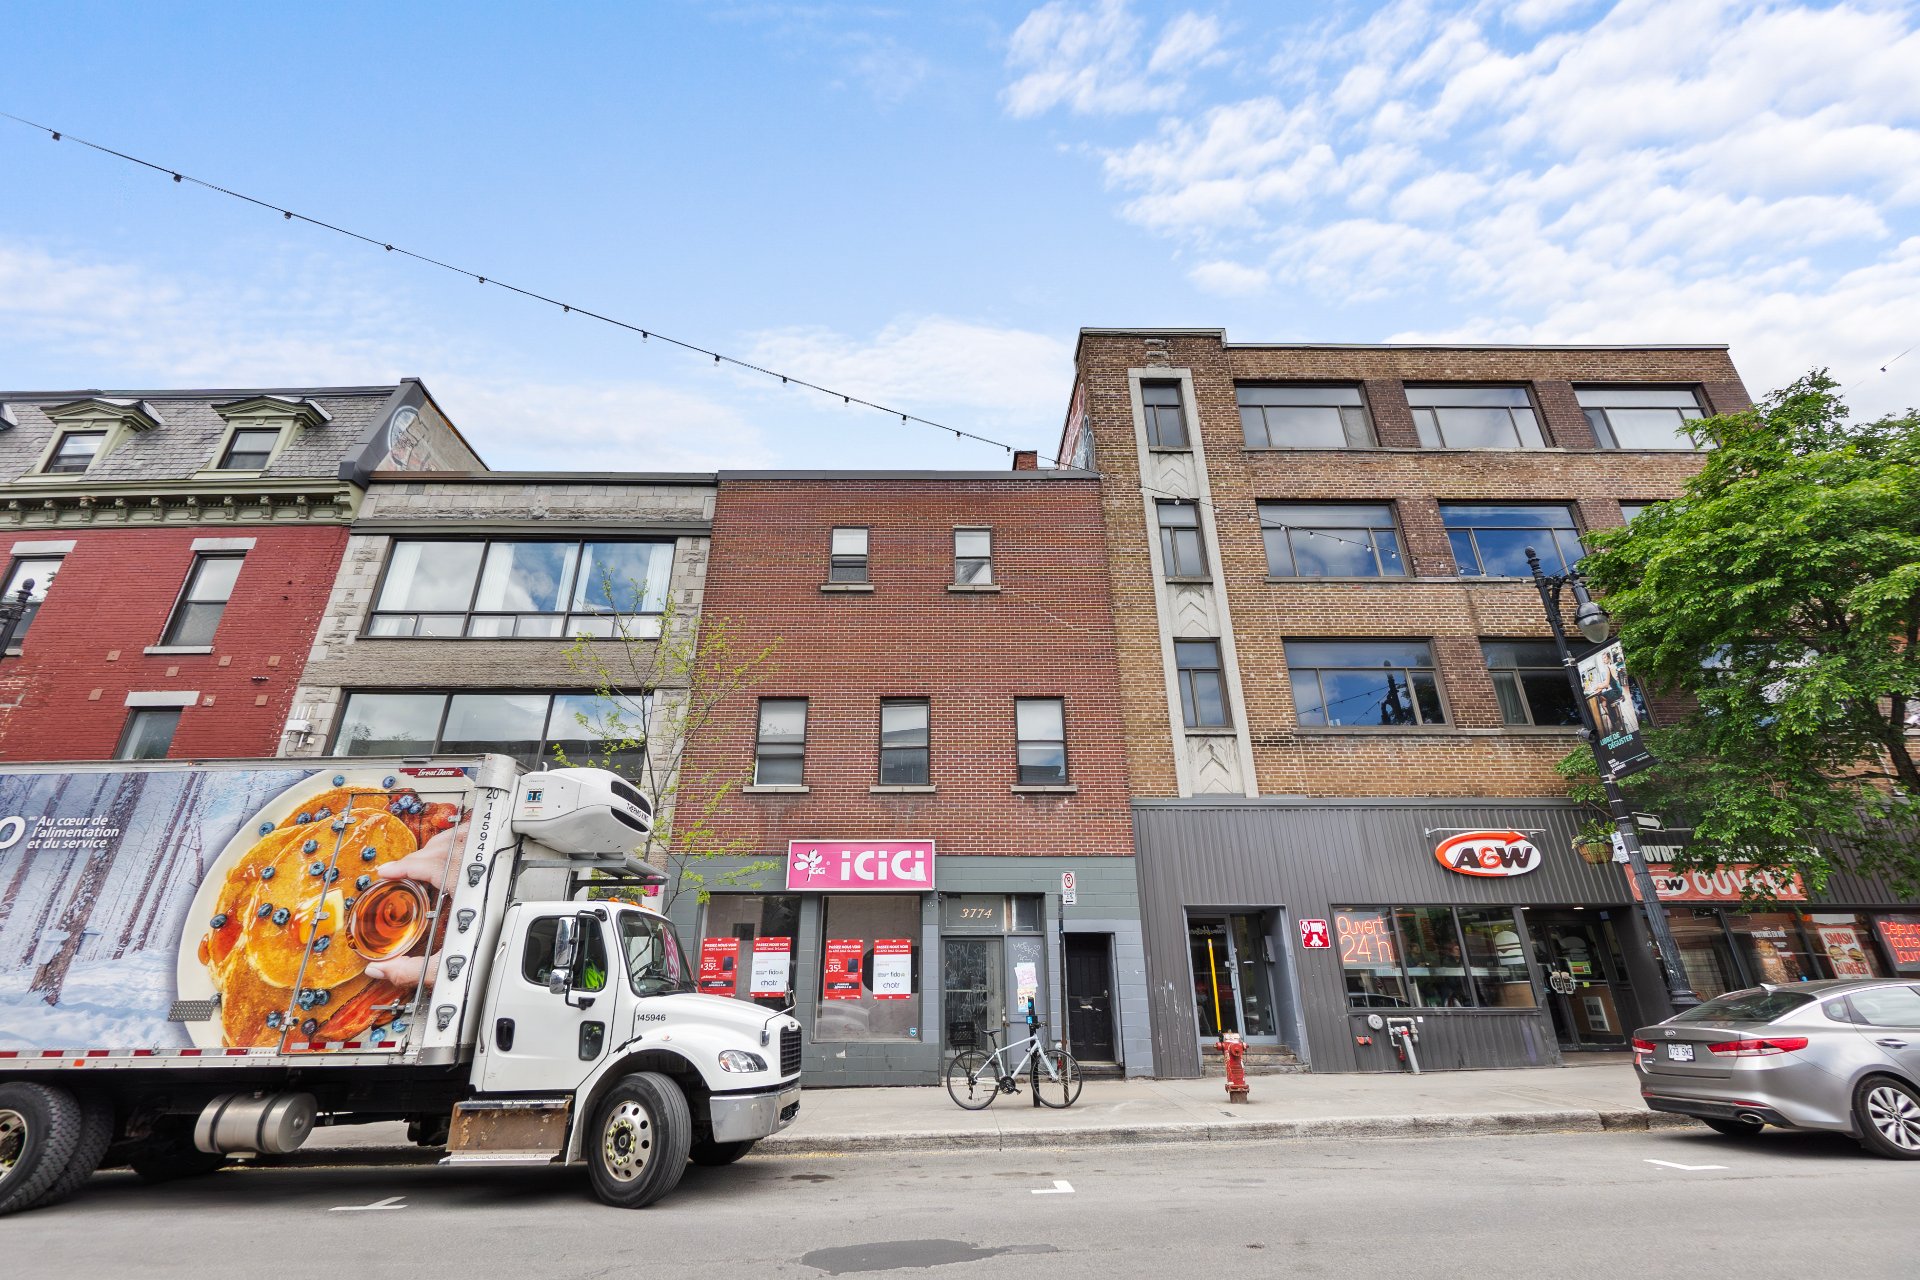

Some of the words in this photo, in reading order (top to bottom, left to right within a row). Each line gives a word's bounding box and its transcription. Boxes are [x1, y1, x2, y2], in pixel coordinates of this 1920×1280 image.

[1607, 733, 1634, 750] DÉGUSTER
[1612, 731, 1621, 740] DE
[486, 788, 499, 799] 20
[37, 815, 54, 827] Au
[57, 816, 91, 827] cœur
[92, 814, 108, 826] de
[32, 826, 119, 838] l'alimentation
[27, 839, 42, 849] et
[43, 837, 60, 849] du
[62, 837, 108, 849] service
[1452, 846, 1533, 869] A&W
[960, 908, 993, 919] 3774
[1337, 913, 1386, 935] Ouvert
[1824, 932, 1855, 945] SMASH
[1340, 935, 1372, 962] 24
[1375, 934, 1392, 963] h
[1836, 961, 1870, 975] BURGER
[637, 1013, 667, 1022] 145946
